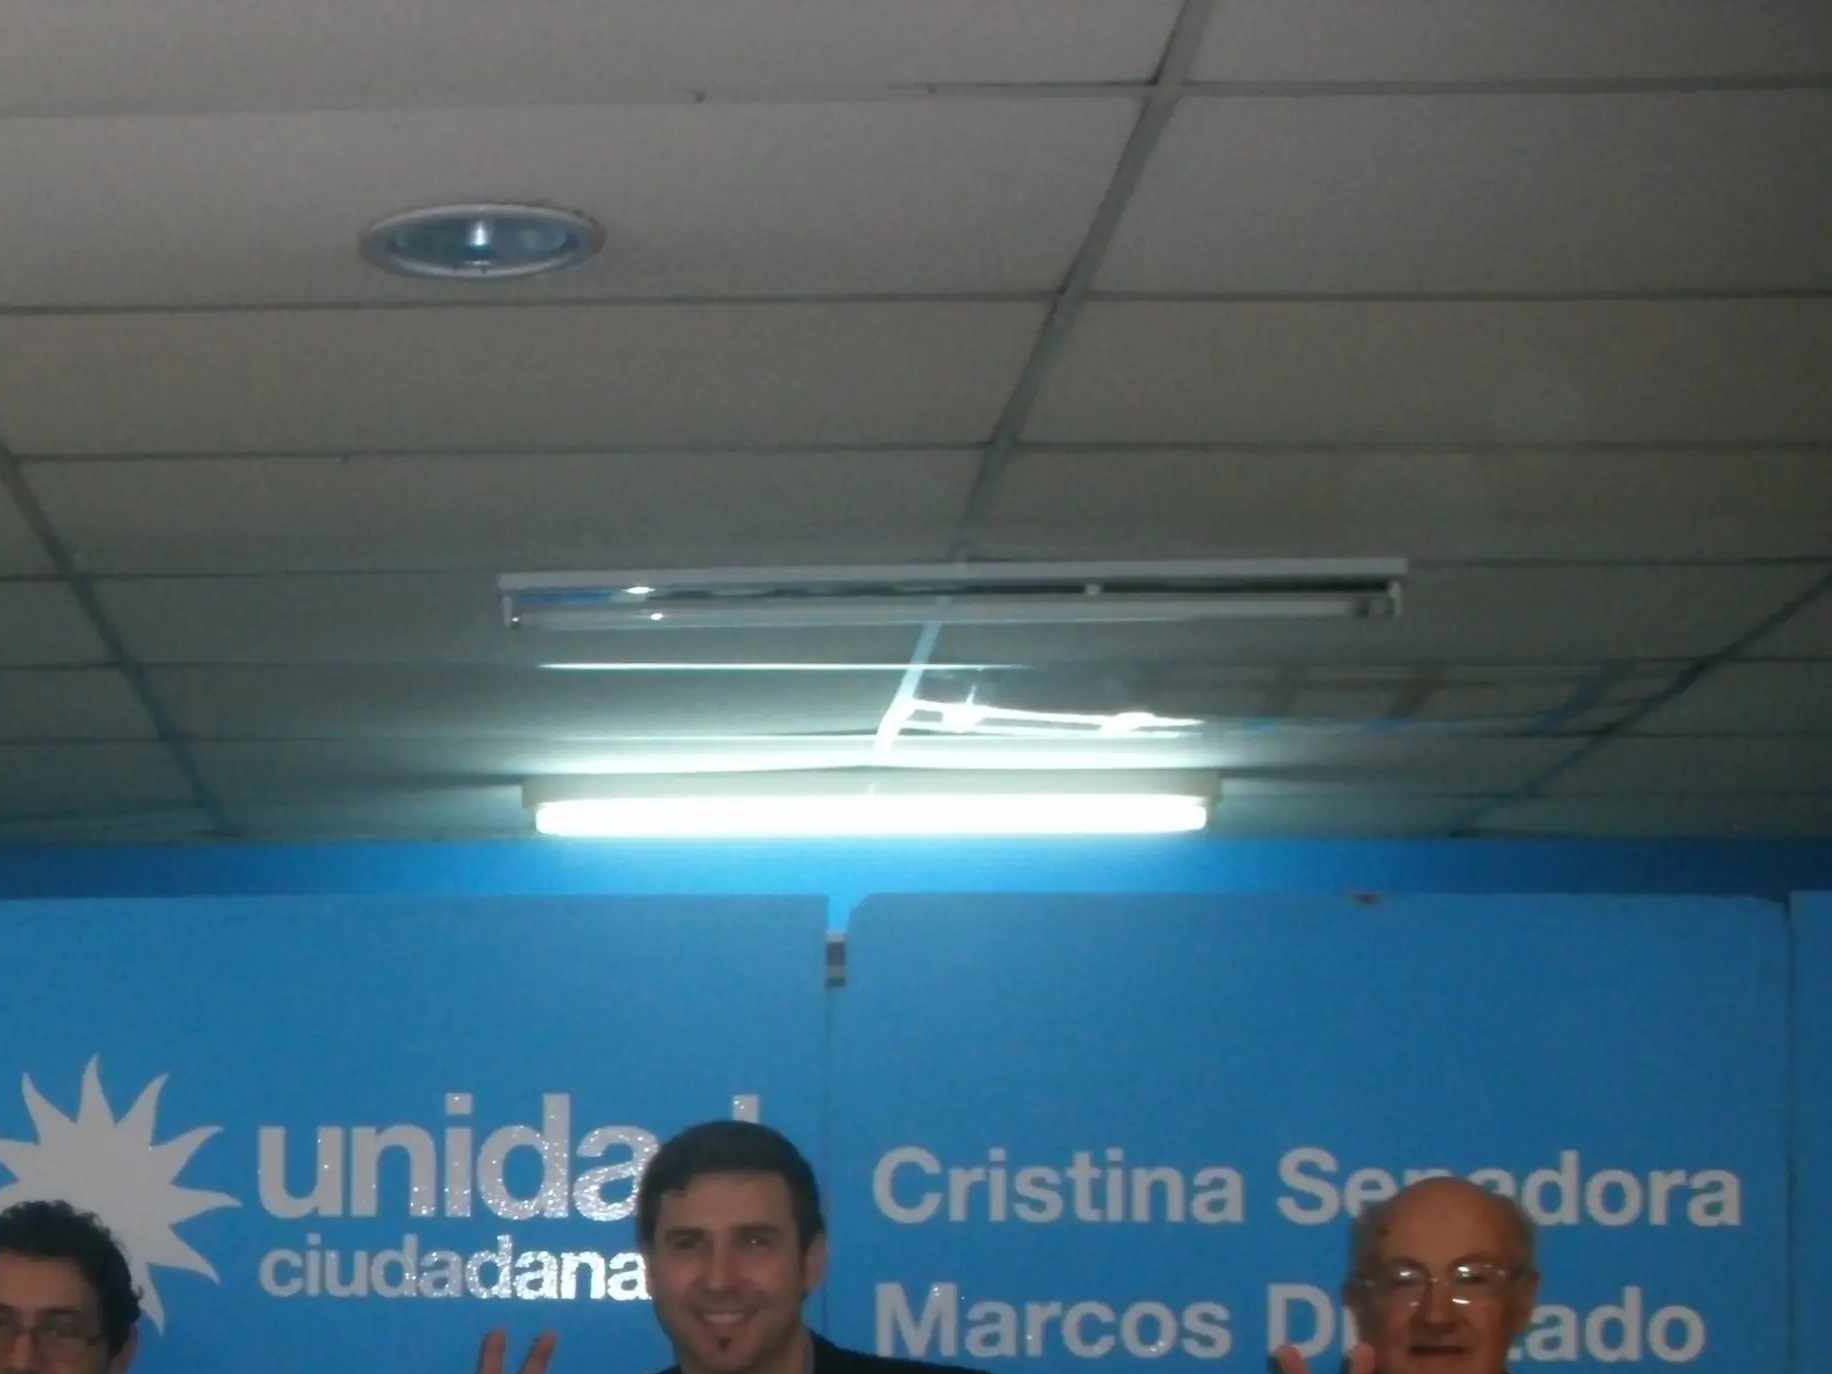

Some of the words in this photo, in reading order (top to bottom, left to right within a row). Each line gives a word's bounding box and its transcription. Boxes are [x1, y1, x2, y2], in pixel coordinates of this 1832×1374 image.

[258, 1093, 760, 1221] unida
[872, 1145, 1246, 1224] Cristina
[1278, 1146, 1742, 1226] Sedora
[259, 1233, 653, 1300] ciudadana
[874, 1281, 1233, 1359] Marcos
